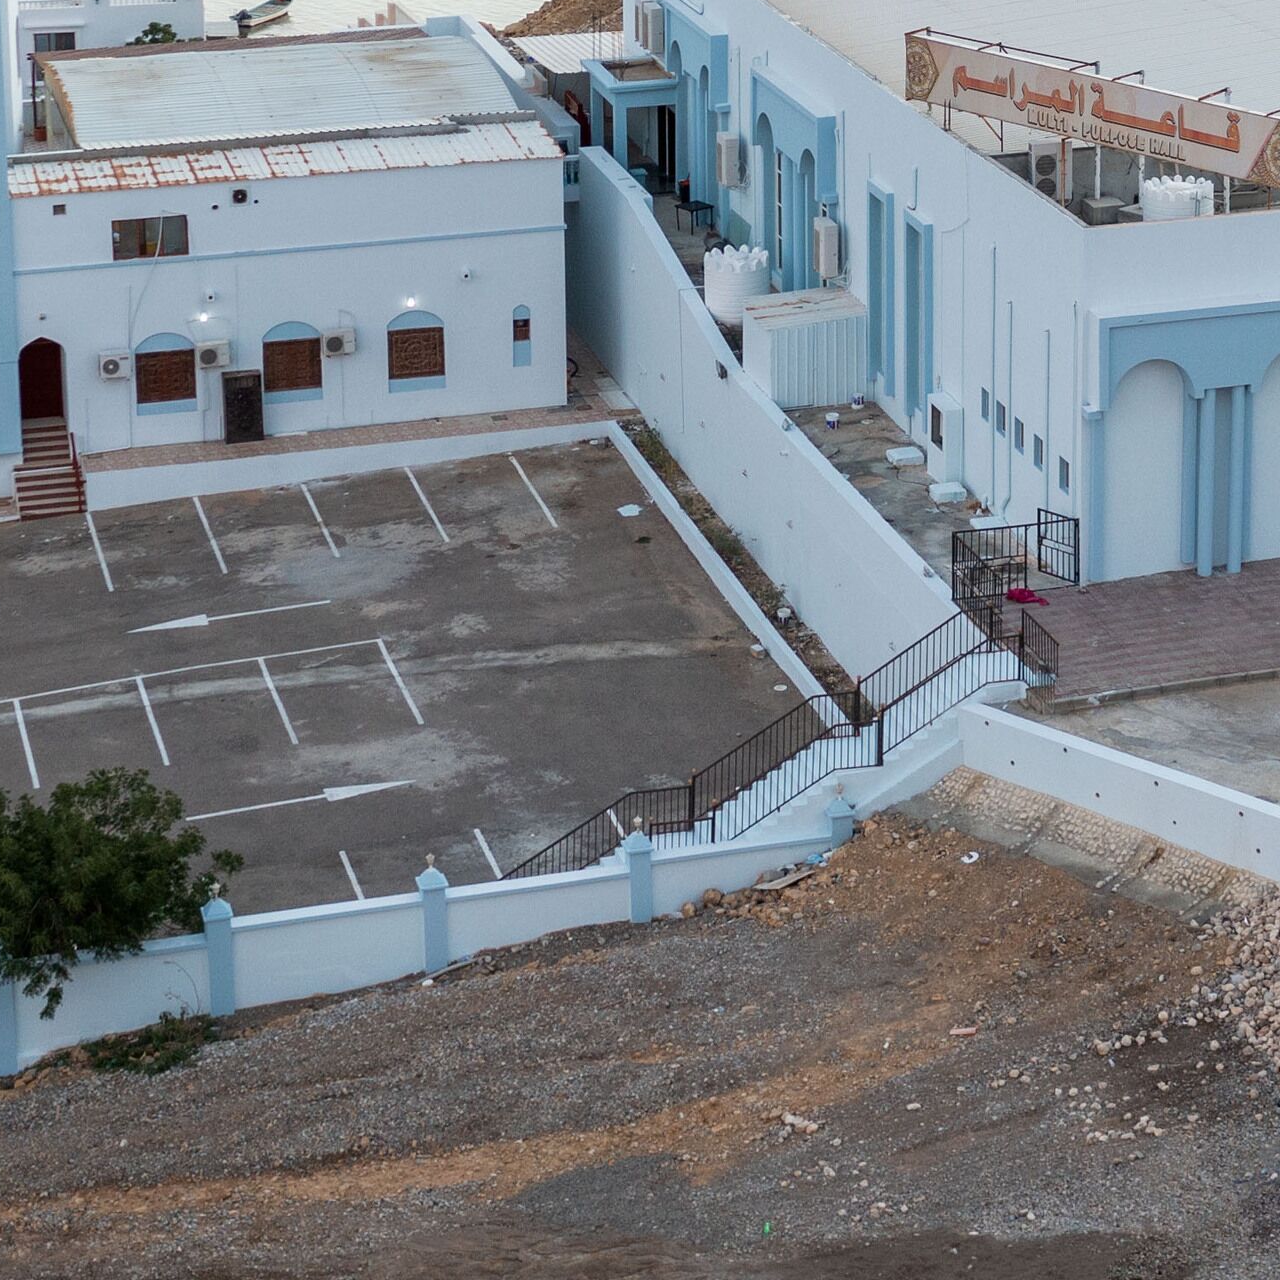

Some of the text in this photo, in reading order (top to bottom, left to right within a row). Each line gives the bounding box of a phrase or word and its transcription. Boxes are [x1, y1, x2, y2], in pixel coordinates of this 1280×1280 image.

[952, 65, 1241, 154] قاعة المراسم
[1082, 121, 1146, 152] PURPOSE
[1149, 136, 1187, 162] HALL
